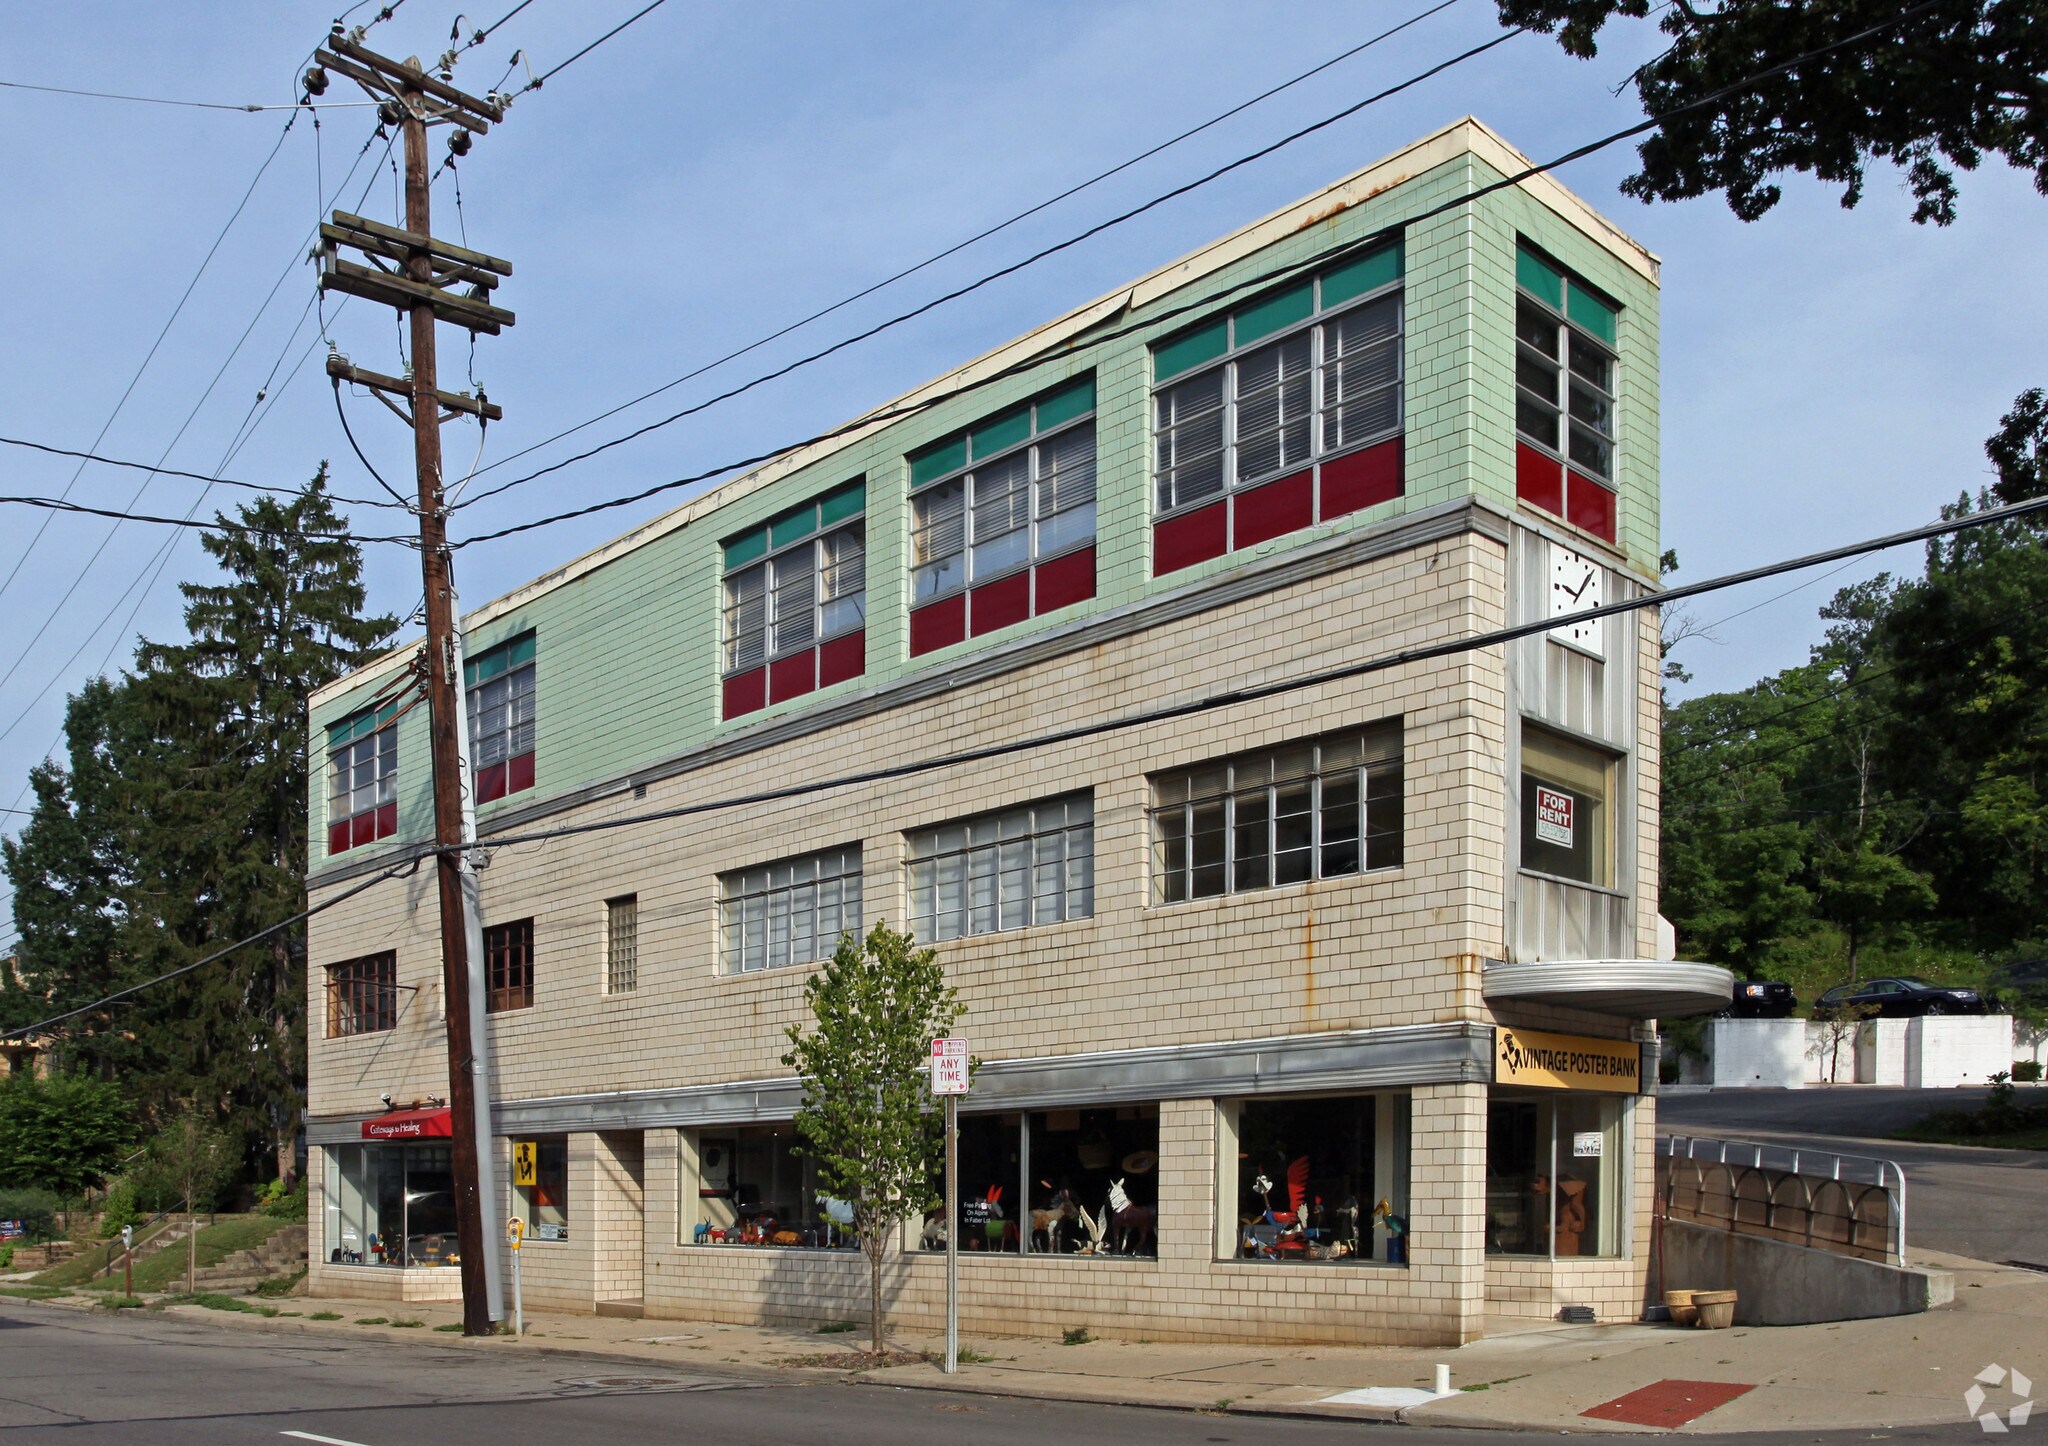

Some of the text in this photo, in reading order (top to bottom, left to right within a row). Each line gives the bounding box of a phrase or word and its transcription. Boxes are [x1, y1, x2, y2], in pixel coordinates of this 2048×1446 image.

[1543, 793, 1566, 812] FOR
[1540, 806, 1570, 826] RENT
[933, 1043, 942, 1054] NO
[940, 1059, 959, 1069] ANY
[1522, 1047, 1636, 1078] VINTAGE POSTER BANK
[939, 1070, 961, 1081] TIME
[370, 1124, 395, 1138] Gateways
[400, 1120, 420, 1135] Healing
[974, 1201, 992, 1210] Pang
